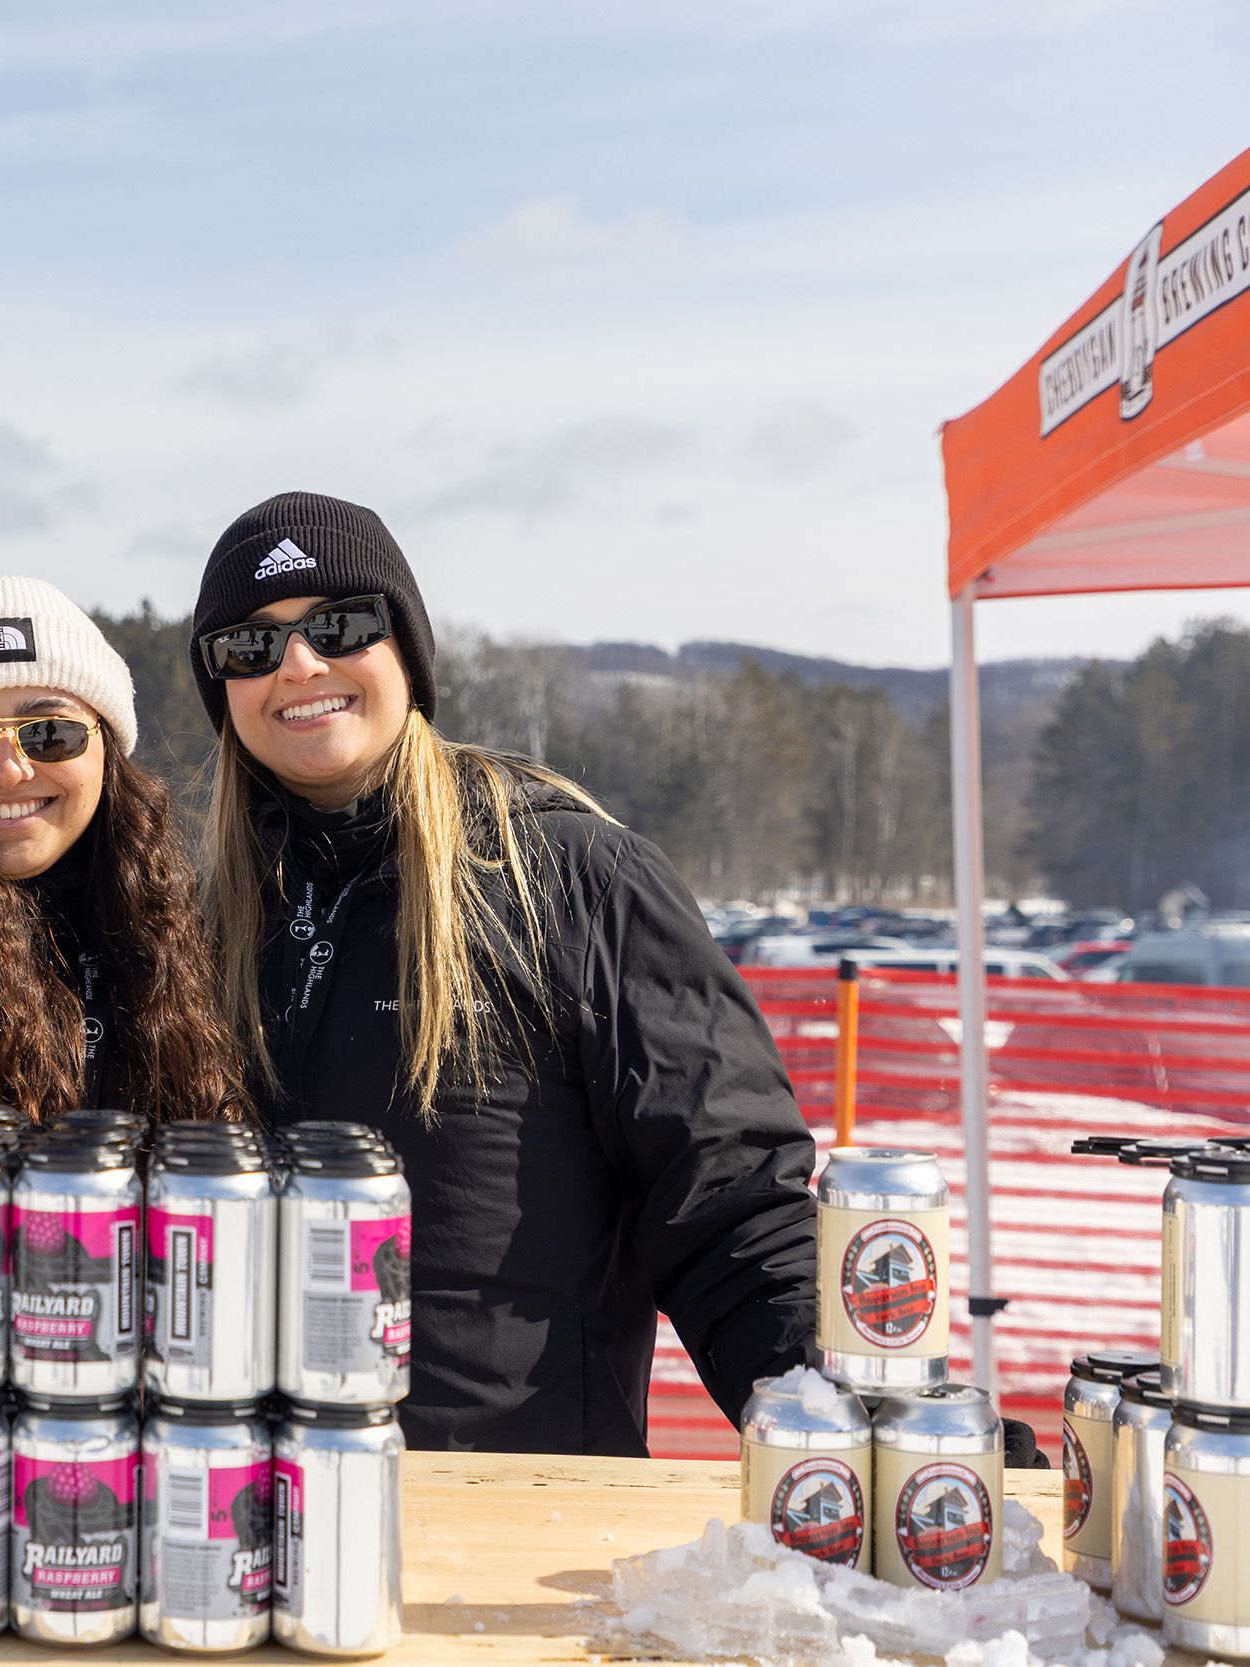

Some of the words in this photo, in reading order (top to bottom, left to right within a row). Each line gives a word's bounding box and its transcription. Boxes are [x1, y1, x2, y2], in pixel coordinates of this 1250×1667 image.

[1162, 228, 1234, 324] BREWING
[1238, 210, 1250, 271] C
[254, 557, 317, 580] adidas
[304, 882, 314, 919] HIGHLANDS
[297, 905, 305, 918] THE
[315, 965, 325, 980] THE
[300, 965, 318, 1009] HIGHLANDS
[374, 1000, 400, 1011] THE
[87, 1044, 96, 1060] THE
[175, 1235, 188, 1272] TOWN
[910, 1284, 927, 1295] Inn
[12, 1291, 94, 1322] RAILYARD
[175, 1273, 188, 1336] MOUNTAIN
[16, 1317, 86, 1336] RASPBERRY
[24, 1542, 123, 1574] RAILYARD
[37, 1570, 117, 1584] RASPBERRY
[84, 1590, 104, 1600] ALE
